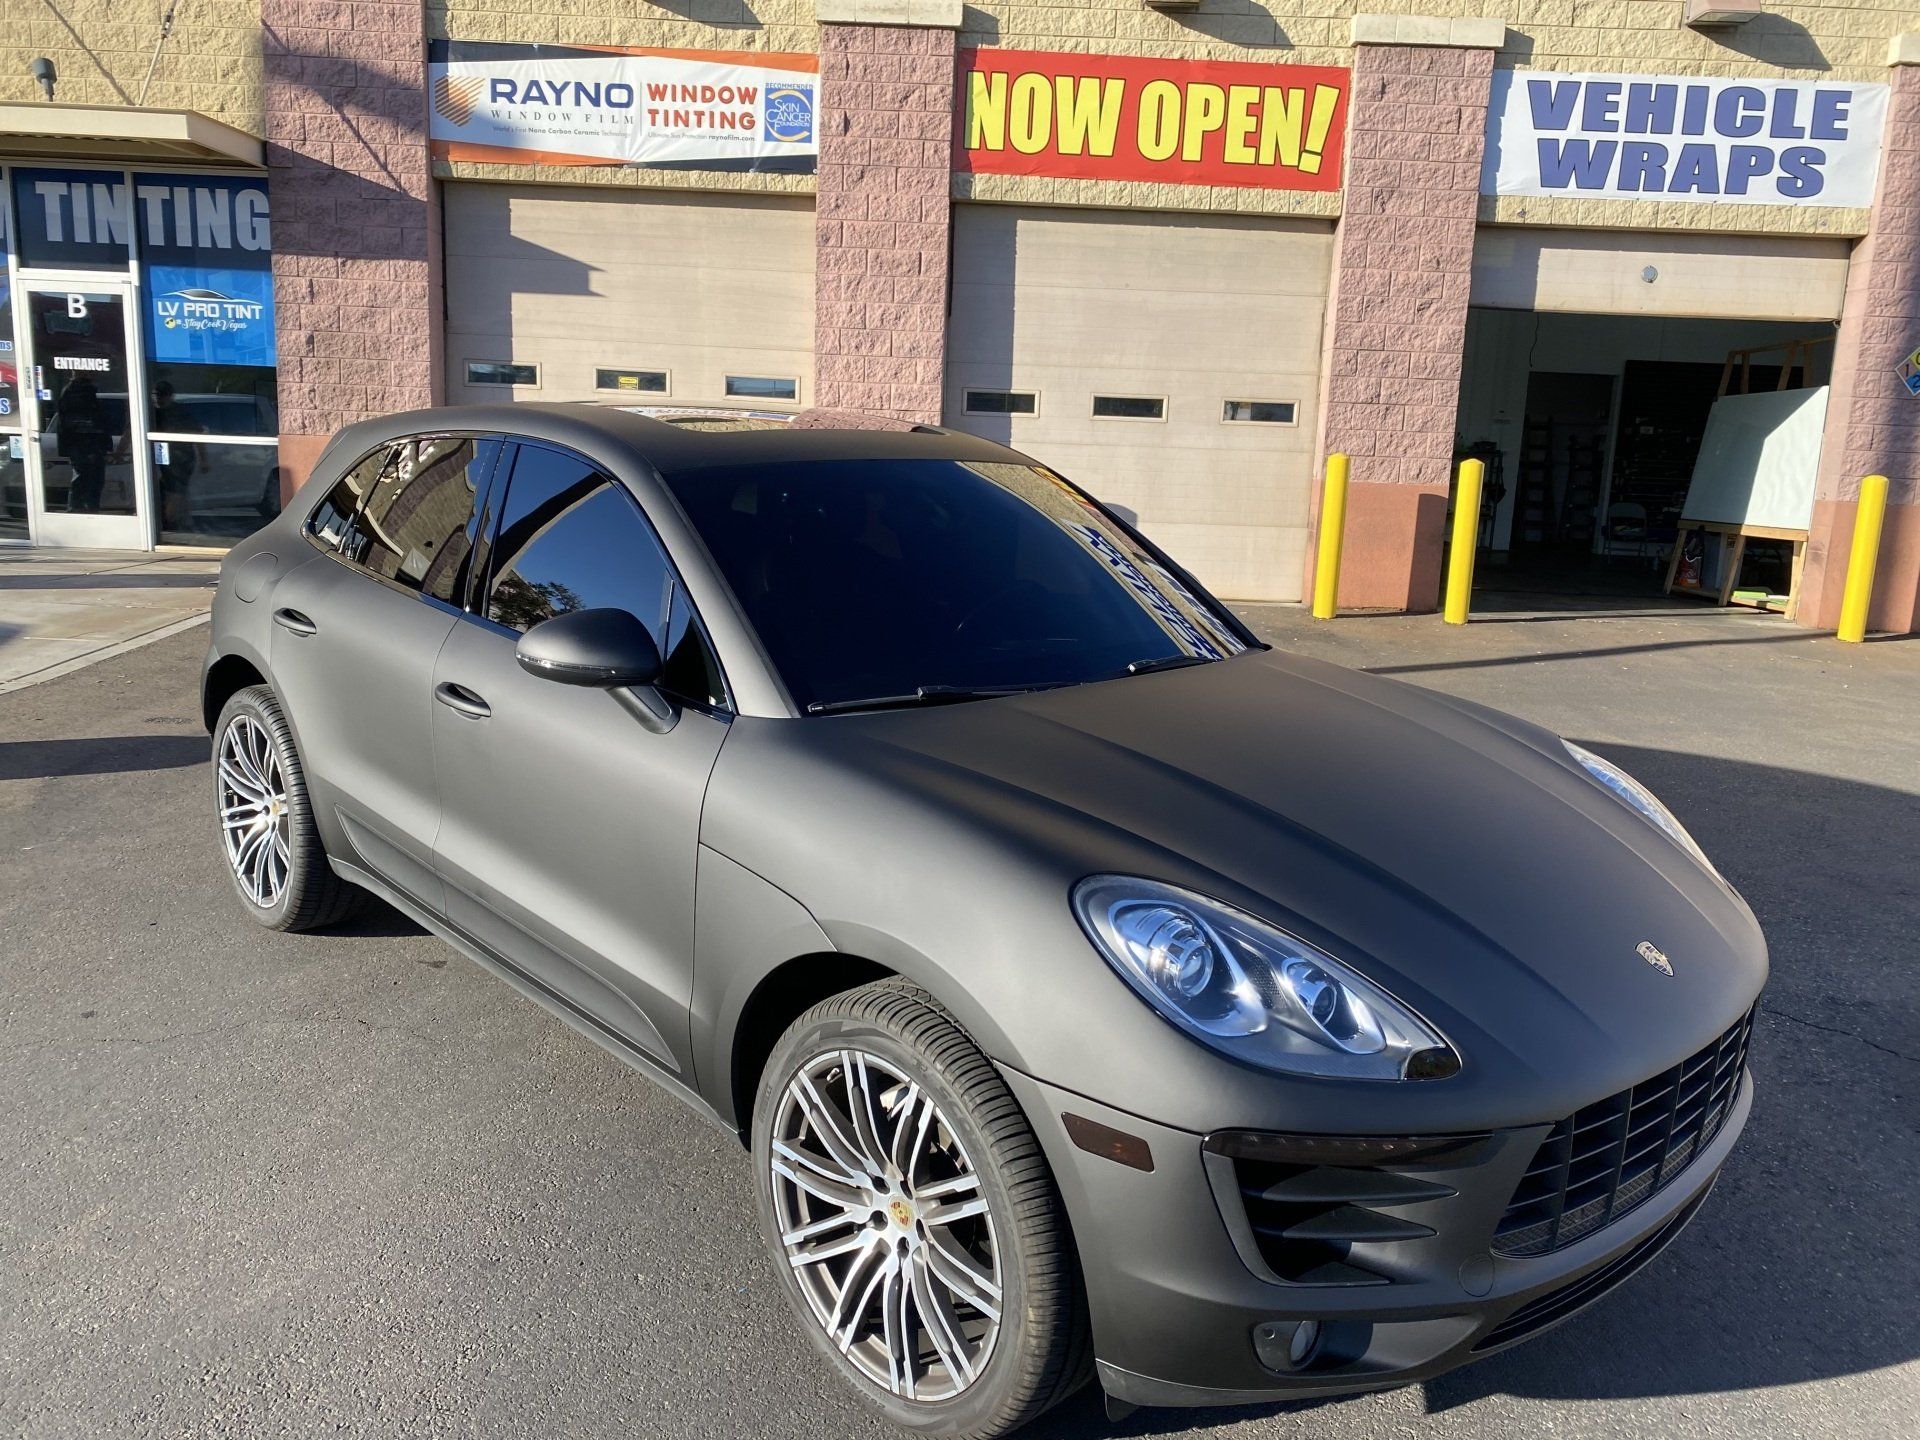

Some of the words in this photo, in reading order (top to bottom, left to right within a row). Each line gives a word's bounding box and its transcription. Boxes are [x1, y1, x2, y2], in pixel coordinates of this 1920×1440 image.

[490, 78, 634, 109] RAYNO
[646, 83, 758, 105] WINDOW
[491, 109, 573, 122] WINDOW
[585, 113, 634, 125] FILM
[647, 108, 756, 131] TINTING
[1527, 80, 1853, 141] VEHICLE
[528, 127, 547, 135] Nano
[547, 128, 572, 136] Carbon
[573, 129, 601, 137] Ceramic
[964, 70, 1126, 157] NOW
[1136, 78, 1340, 175] OPEN!
[708, 133, 756, 142] raynofilm.com
[1537, 138, 1827, 198] WRAPS
[34, 181, 272, 251] TINTING
[67, 293, 88, 319] B
[157, 301, 180, 316] LV
[183, 303, 220, 318] PRO
[223, 304, 263, 320] TINT
[53, 356, 111, 372] ENTRANCE
